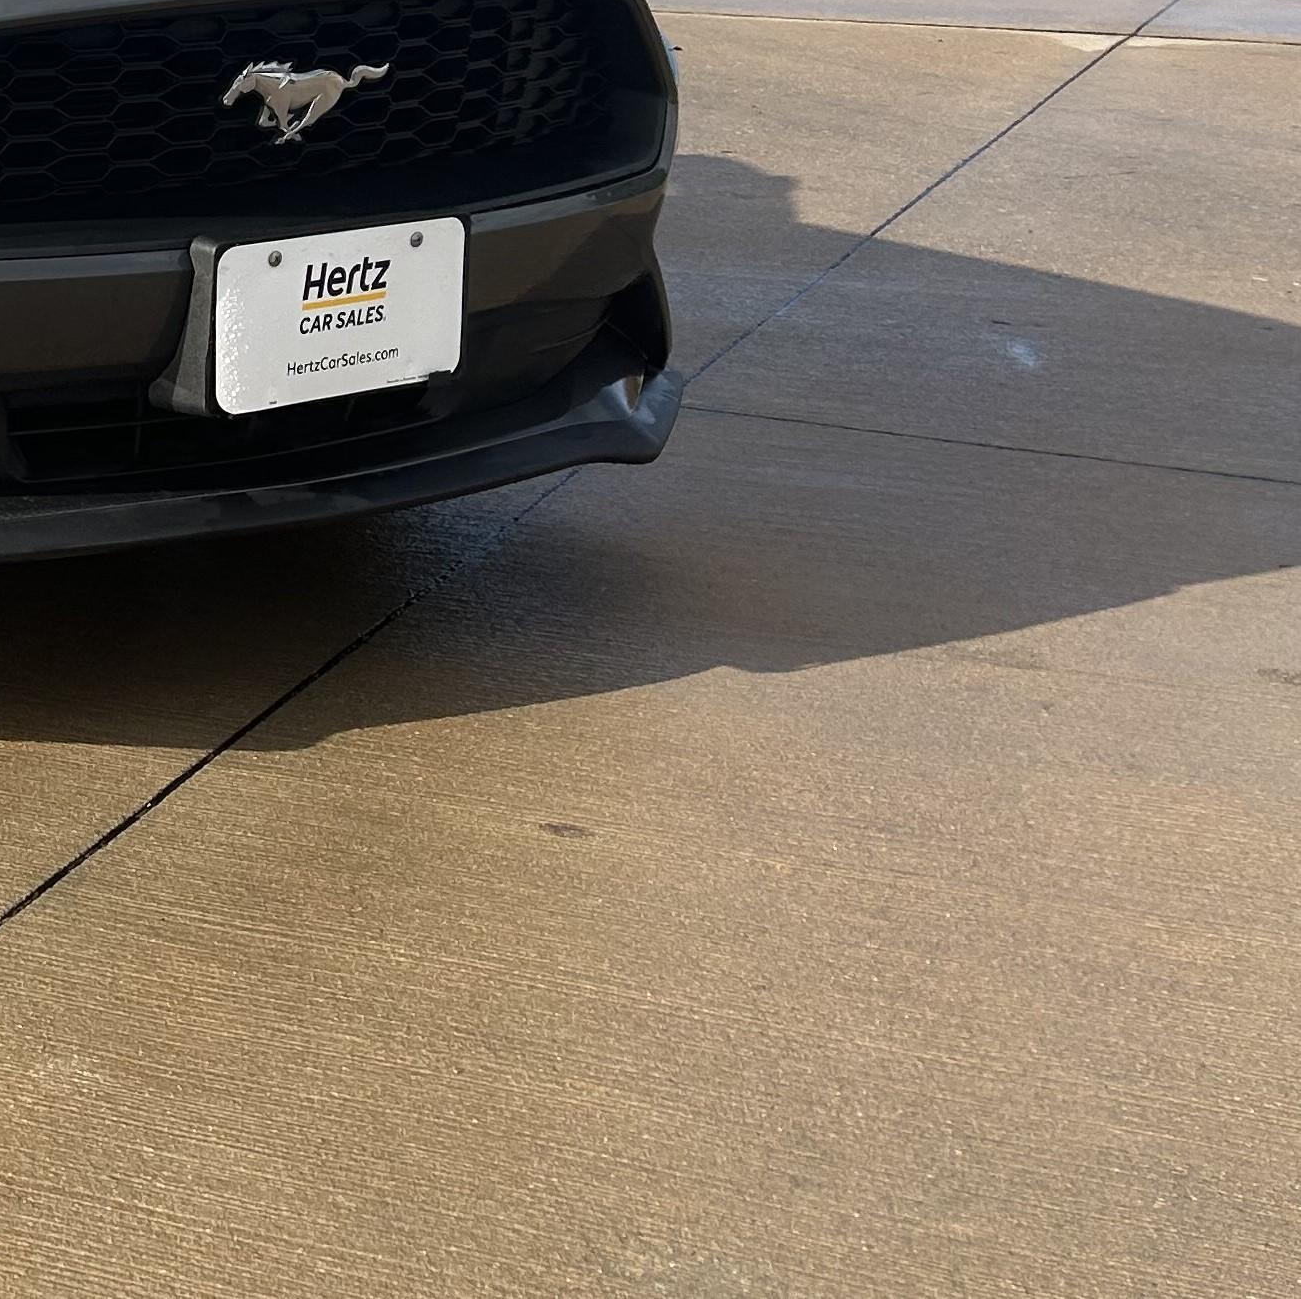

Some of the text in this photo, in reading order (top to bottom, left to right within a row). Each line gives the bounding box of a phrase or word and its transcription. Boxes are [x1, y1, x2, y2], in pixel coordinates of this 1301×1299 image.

[302, 256, 391, 301] Hertz
[299, 305, 385, 335] CAR SALES
[286, 347, 399, 376] HertzCarSales.com
